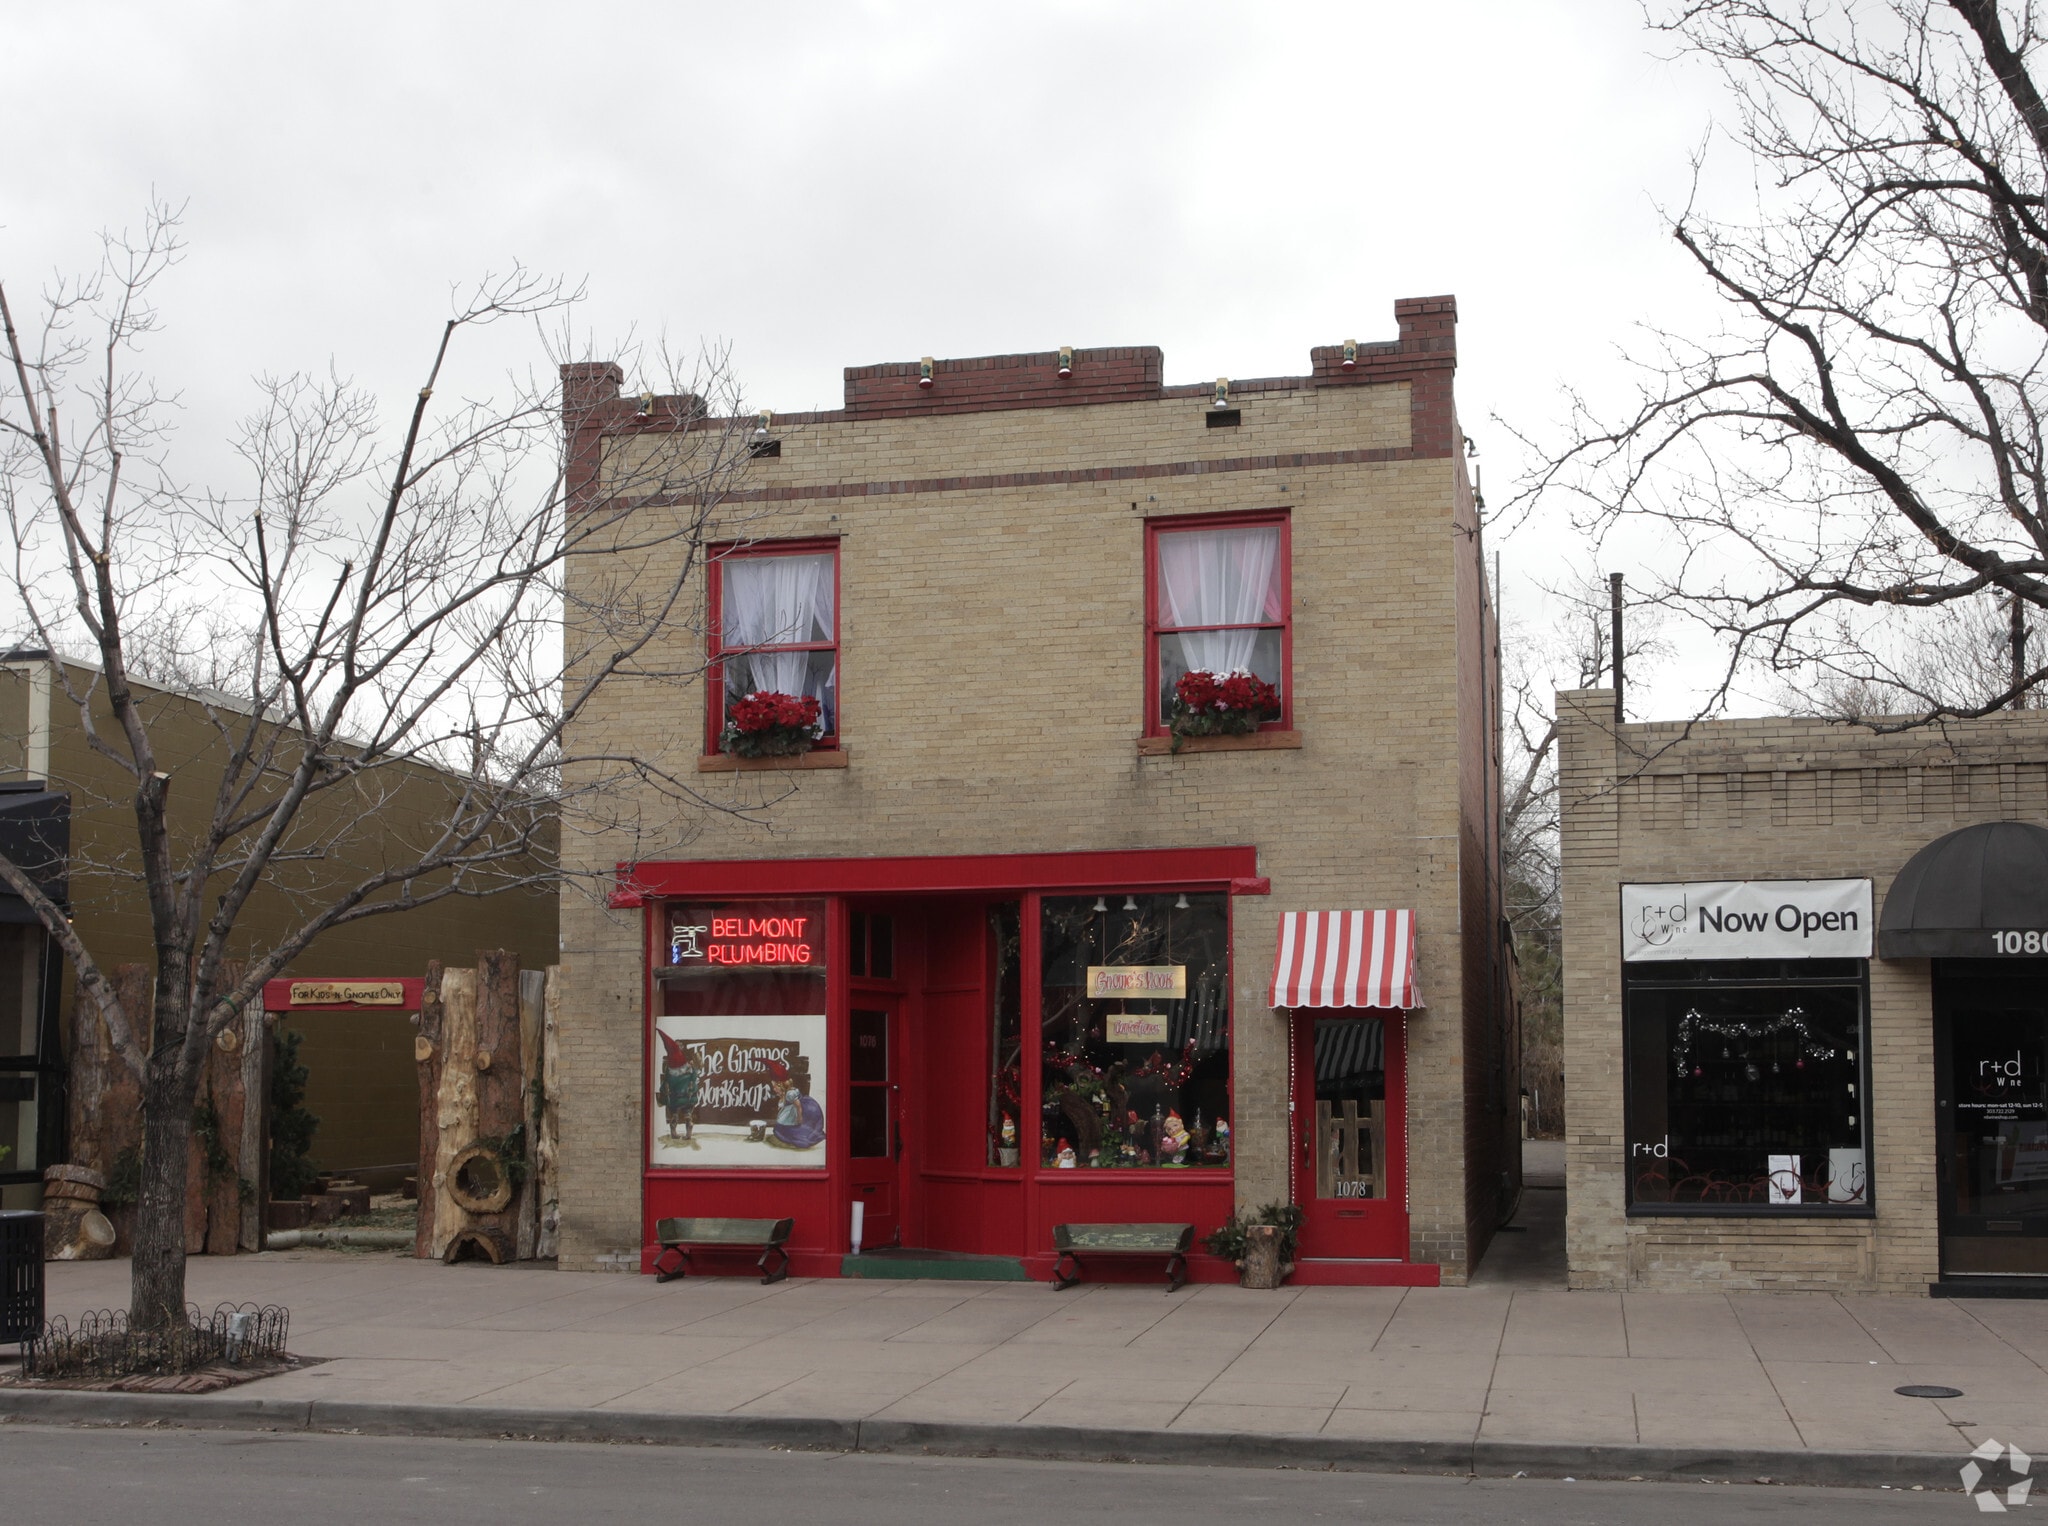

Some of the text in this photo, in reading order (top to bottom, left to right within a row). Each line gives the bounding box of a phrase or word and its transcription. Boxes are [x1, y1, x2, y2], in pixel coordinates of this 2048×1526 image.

[1642, 893, 1687, 923] r+d
[1699, 904, 1858, 938] Now Open
[711, 918, 808, 938] BELMONT
[708, 942, 812, 964] PLUMBING
[686, 1042, 790, 1076] The Gnomes
[1979, 1049, 2021, 1076] r+d
[694, 1076, 772, 1113] Workshop
[1632, 1135, 1669, 1158] r+d
[1337, 1181, 1366, 1197] 1078
